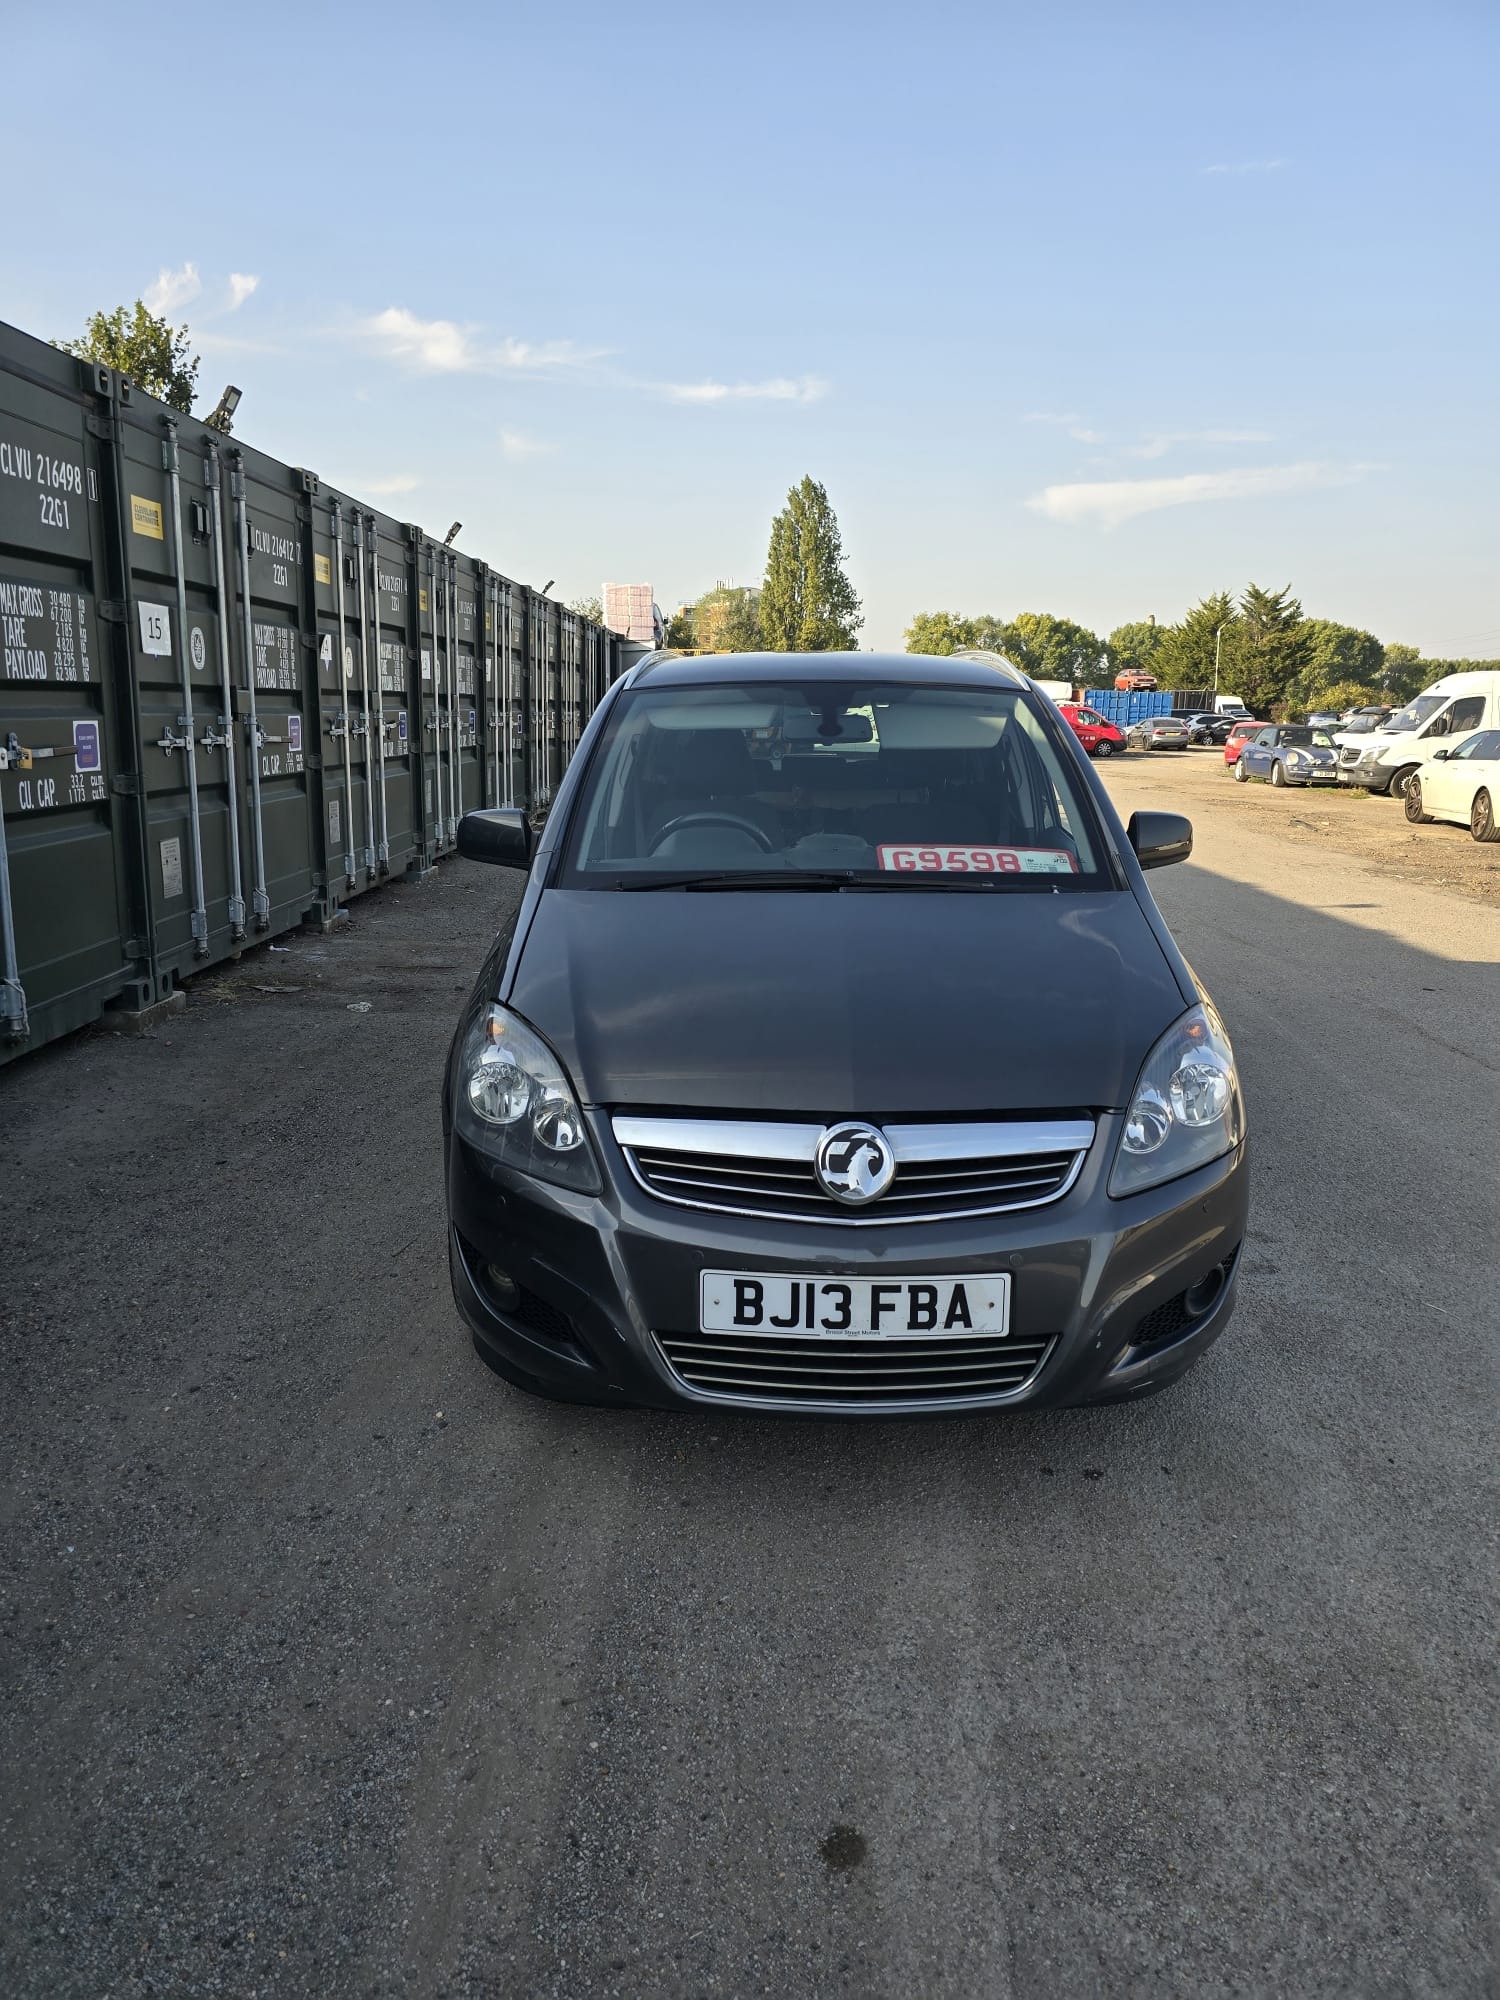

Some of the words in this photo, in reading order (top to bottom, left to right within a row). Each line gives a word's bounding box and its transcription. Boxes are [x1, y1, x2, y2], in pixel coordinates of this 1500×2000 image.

[0, 442, 31, 480] CLVU
[37, 453, 82, 495] 216498
[40, 493, 69, 530] 22G1
[255, 529, 270, 553] CLVU
[272, 535, 294, 561] 216412
[273, 563, 288, 587] 22G1
[0, 582, 18, 615] MAX
[18, 585, 43, 618] GROSS
[2, 615, 27, 648] TARE
[147, 616, 162, 640] 15
[4, 648, 47, 680] PAYLOAD
[255, 645, 268, 667] TARE
[256, 667, 277, 688] PAYLOAD
[19, 780, 35, 810] CU.
[37, 778, 59, 808] CAP.
[70, 774, 85, 789] 33.2
[892, 850, 1022, 872] G9598
[733, 1278, 852, 1331] BJ13
[870, 1282, 974, 1331] FBA
